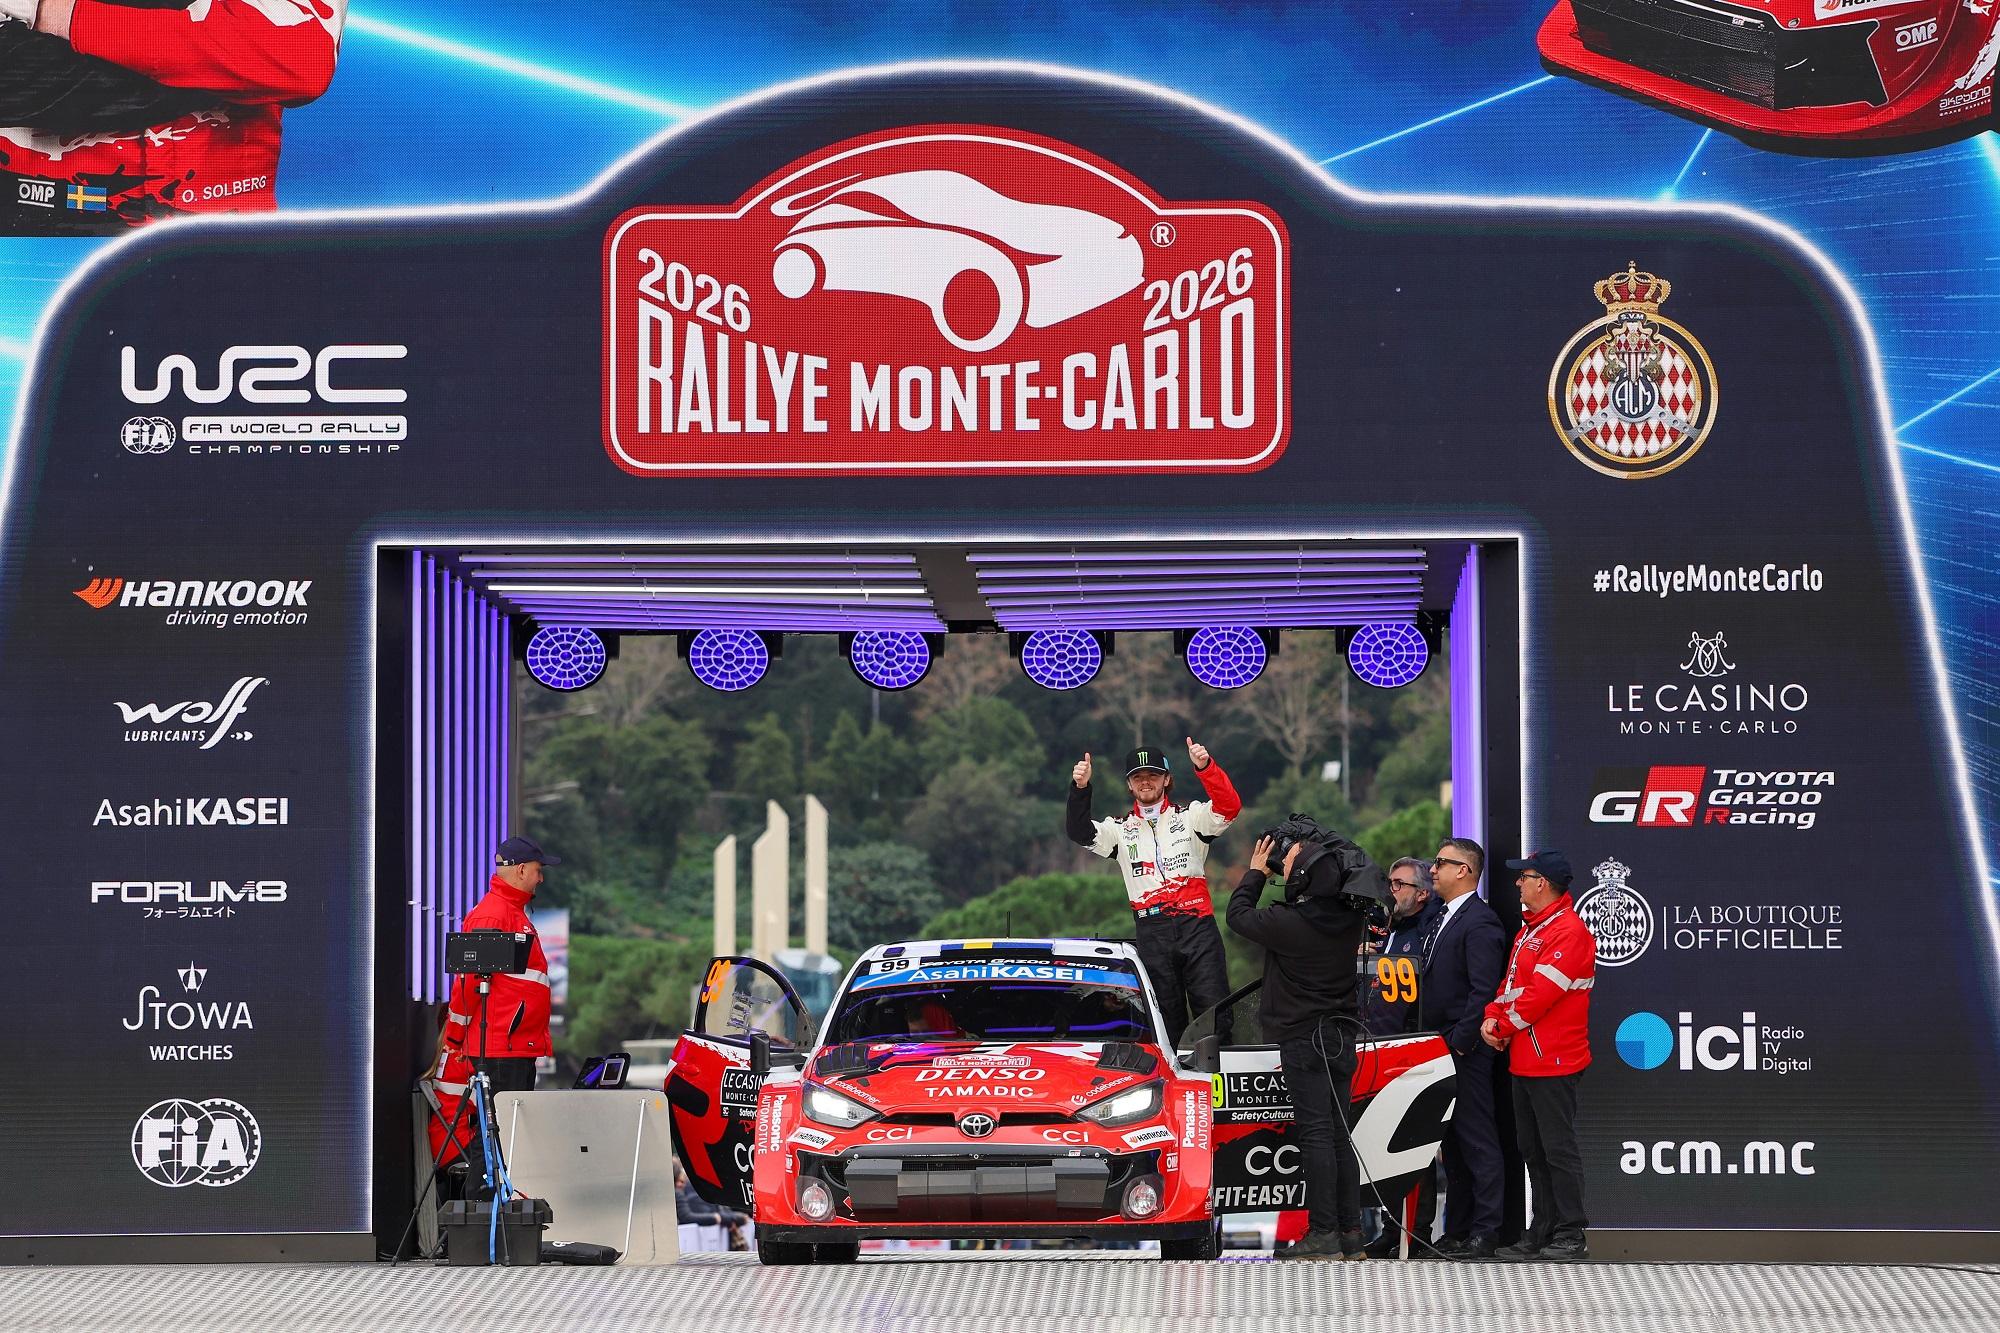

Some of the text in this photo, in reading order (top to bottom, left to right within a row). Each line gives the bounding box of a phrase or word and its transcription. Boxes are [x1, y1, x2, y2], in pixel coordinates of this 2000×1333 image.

[1895, 23, 1938, 47] OMP
[1939, 86, 1991, 108] akebono
[18, 183, 56, 203] OMP
[182, 176, 267, 203] O. SOLBERG
[638, 247, 751, 332] 2026
[1143, 247, 1254, 331] 2026
[121, 345, 408, 404] WRC
[638, 297, 1255, 433] RALLYE MONTE-CARLO
[189, 422, 401, 434] FIA WORLD RALLY
[189, 444, 401, 454] CHAMPIONSHIP
[1593, 564, 1823, 598] #RallyeMonteCarlo
[166, 610, 308, 629] driving emotion
[1608, 684, 1809, 712] LE CASINO
[124, 730, 206, 742] LUBRICANTS
[1712, 769, 1836, 787] TOYOTA
[1588, 791, 1696, 824] GR
[1708, 788, 1823, 807] GAZOO
[1704, 807, 1817, 830] Racing
[91, 880, 288, 904] FORUM8
[143, 906, 236, 919] フォーラムエイト
[1674, 905, 1843, 929] LA BOUTIQUE
[1674, 928, 1843, 949] OFFICIELLE
[879, 959, 911, 973] 99
[990, 958, 1051, 966] GAZOO
[1053, 960, 1109, 970] Racing
[1377, 957, 1417, 1003] 99
[122, 985, 254, 1031] STOWA
[1679, 1011, 1757, 1071] ici
[1762, 1026, 1805, 1039] Radio
[149, 1045, 233, 1061] WATCHES
[1763, 1042, 1781, 1055] TV
[914, 1068, 1046, 1081] DENSO
[1762, 1058, 1812, 1074] Digital
[724, 1073, 766, 1090] LE CASIN
[925, 1085, 1034, 1097] TAMADIC
[1085, 1075, 1133, 1097] codebeamer
[1230, 1076, 1288, 1092] LE CAS
[758, 1095, 771, 1155] AUTOMOTIVE
[771, 1094, 787, 1152] Panasonic
[1182, 1091, 1195, 1148] Panasonic
[1198, 1091, 1208, 1150] AUTOMOTIVE
[1231, 1110, 1295, 1122] SafetyCulture
[866, 1127, 913, 1141] CCI
[1042, 1129, 1089, 1143] CCI
[1245, 1144, 1301, 1175] CC
[1620, 1140, 1816, 1175] acm.mc
